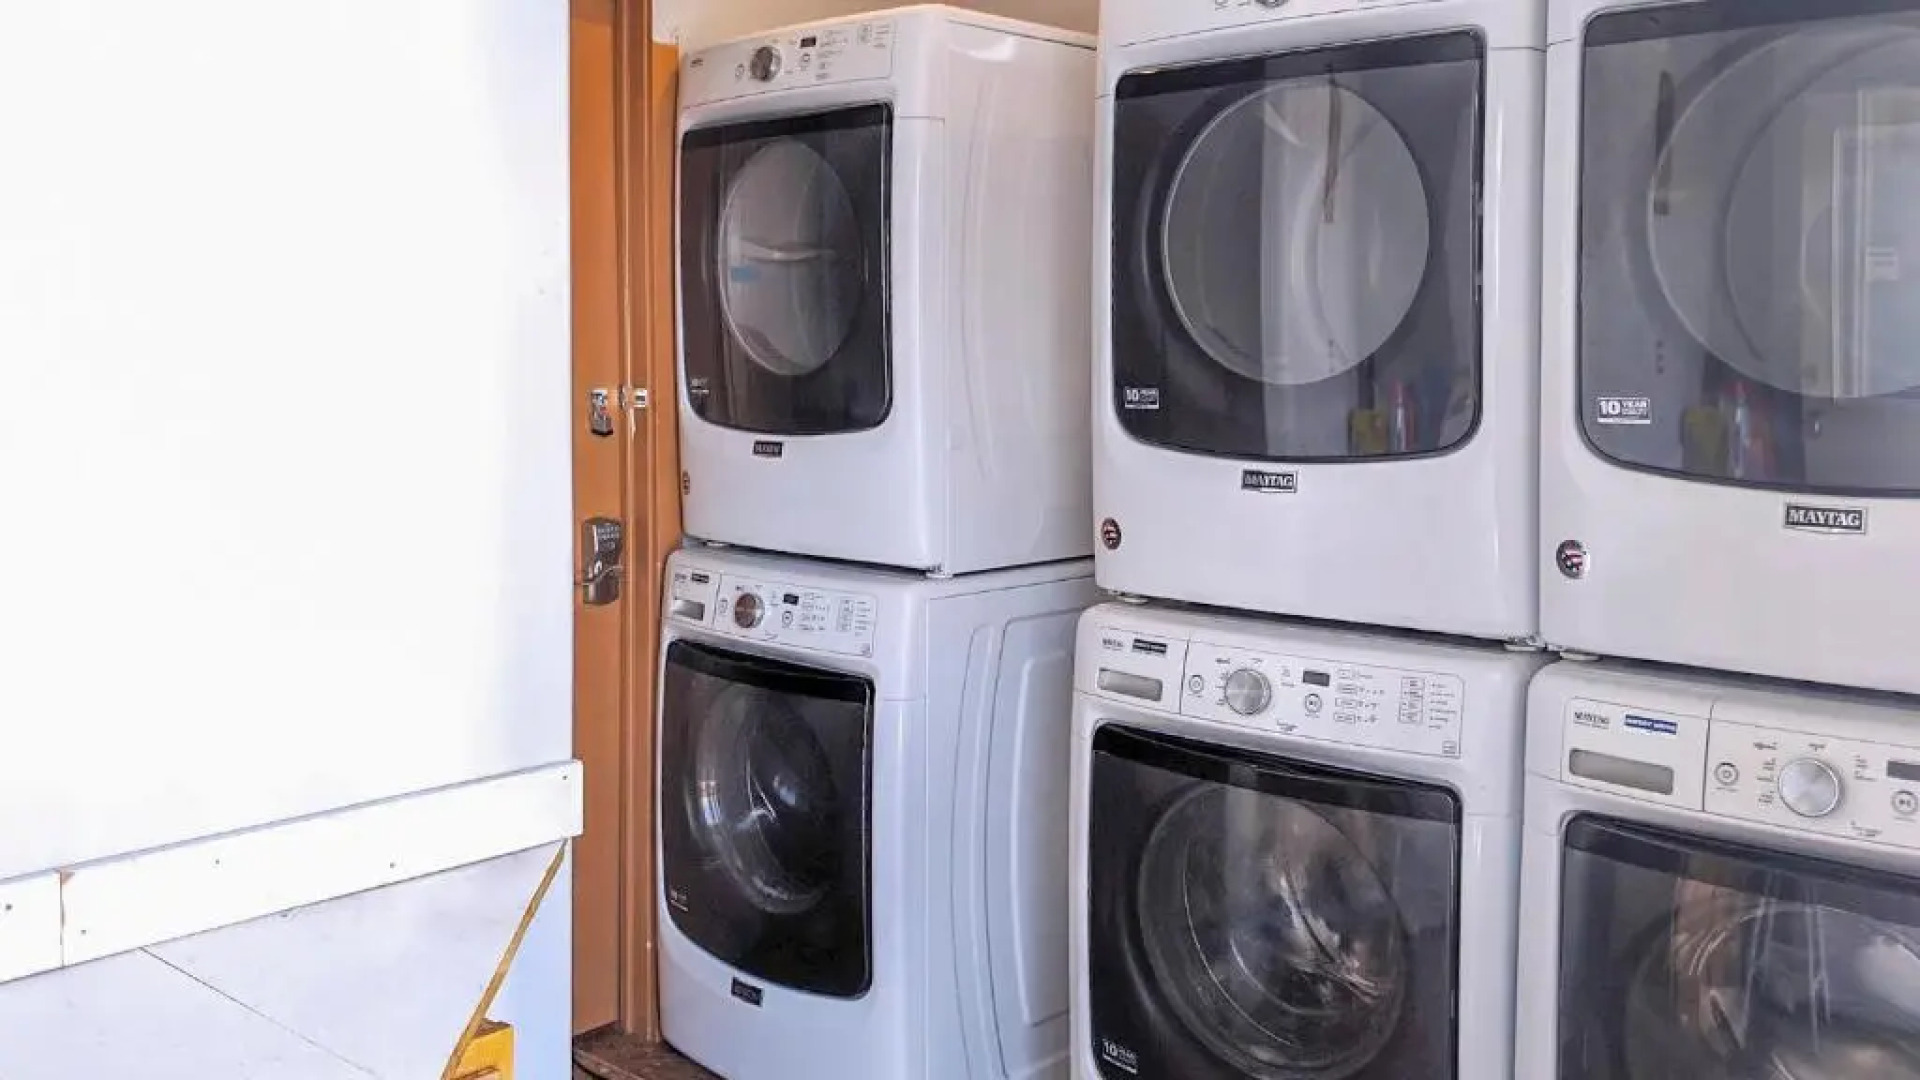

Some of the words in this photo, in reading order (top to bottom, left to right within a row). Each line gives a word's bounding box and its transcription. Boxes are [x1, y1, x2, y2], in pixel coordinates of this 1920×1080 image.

[1126, 389, 1139, 402] 10
[1599, 400, 1620, 415] 10
[1788, 509, 1861, 526] MAYTAG
[1104, 1041, 1118, 1057] 10
